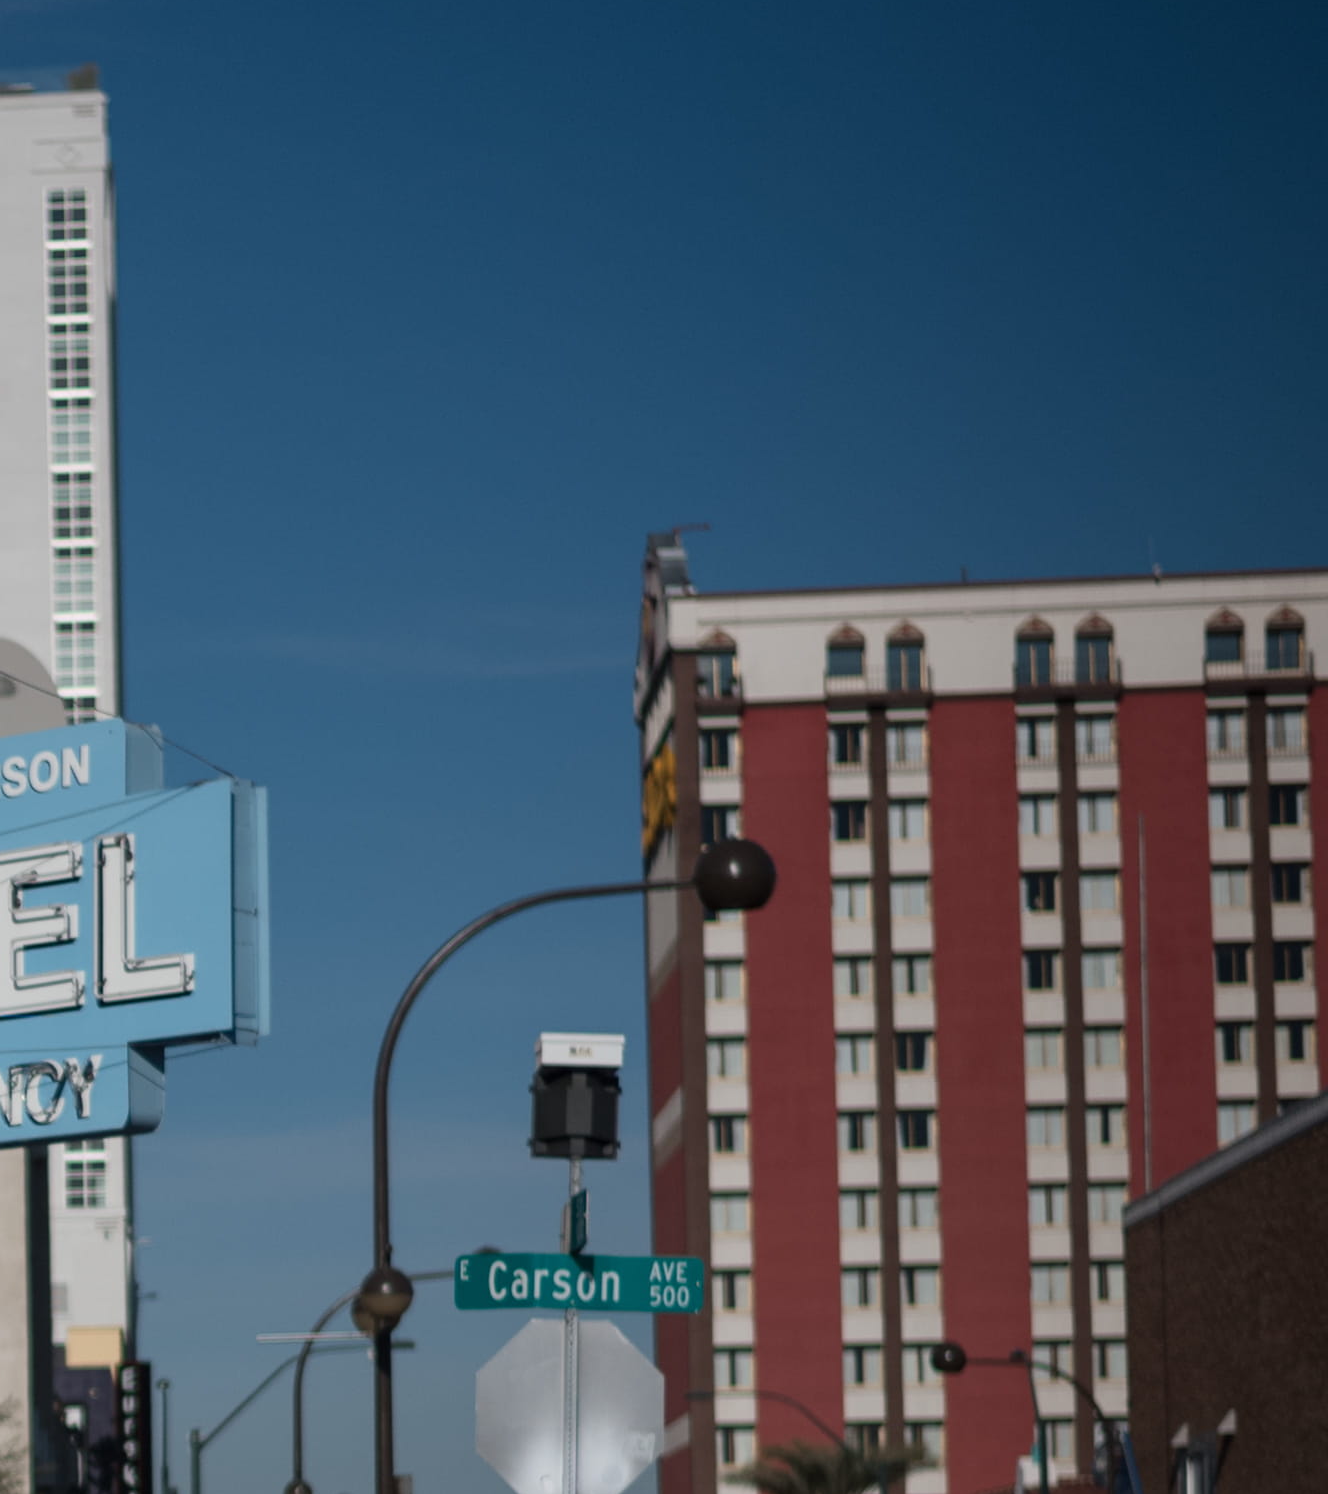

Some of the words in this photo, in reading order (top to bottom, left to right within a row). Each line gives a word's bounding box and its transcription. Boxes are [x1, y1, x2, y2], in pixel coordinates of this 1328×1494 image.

[460, 1259, 469, 1281] E
[488, 1260, 621, 1303] Carson
[649, 1261, 688, 1283] AVE
[649, 1285, 690, 1308] 500
